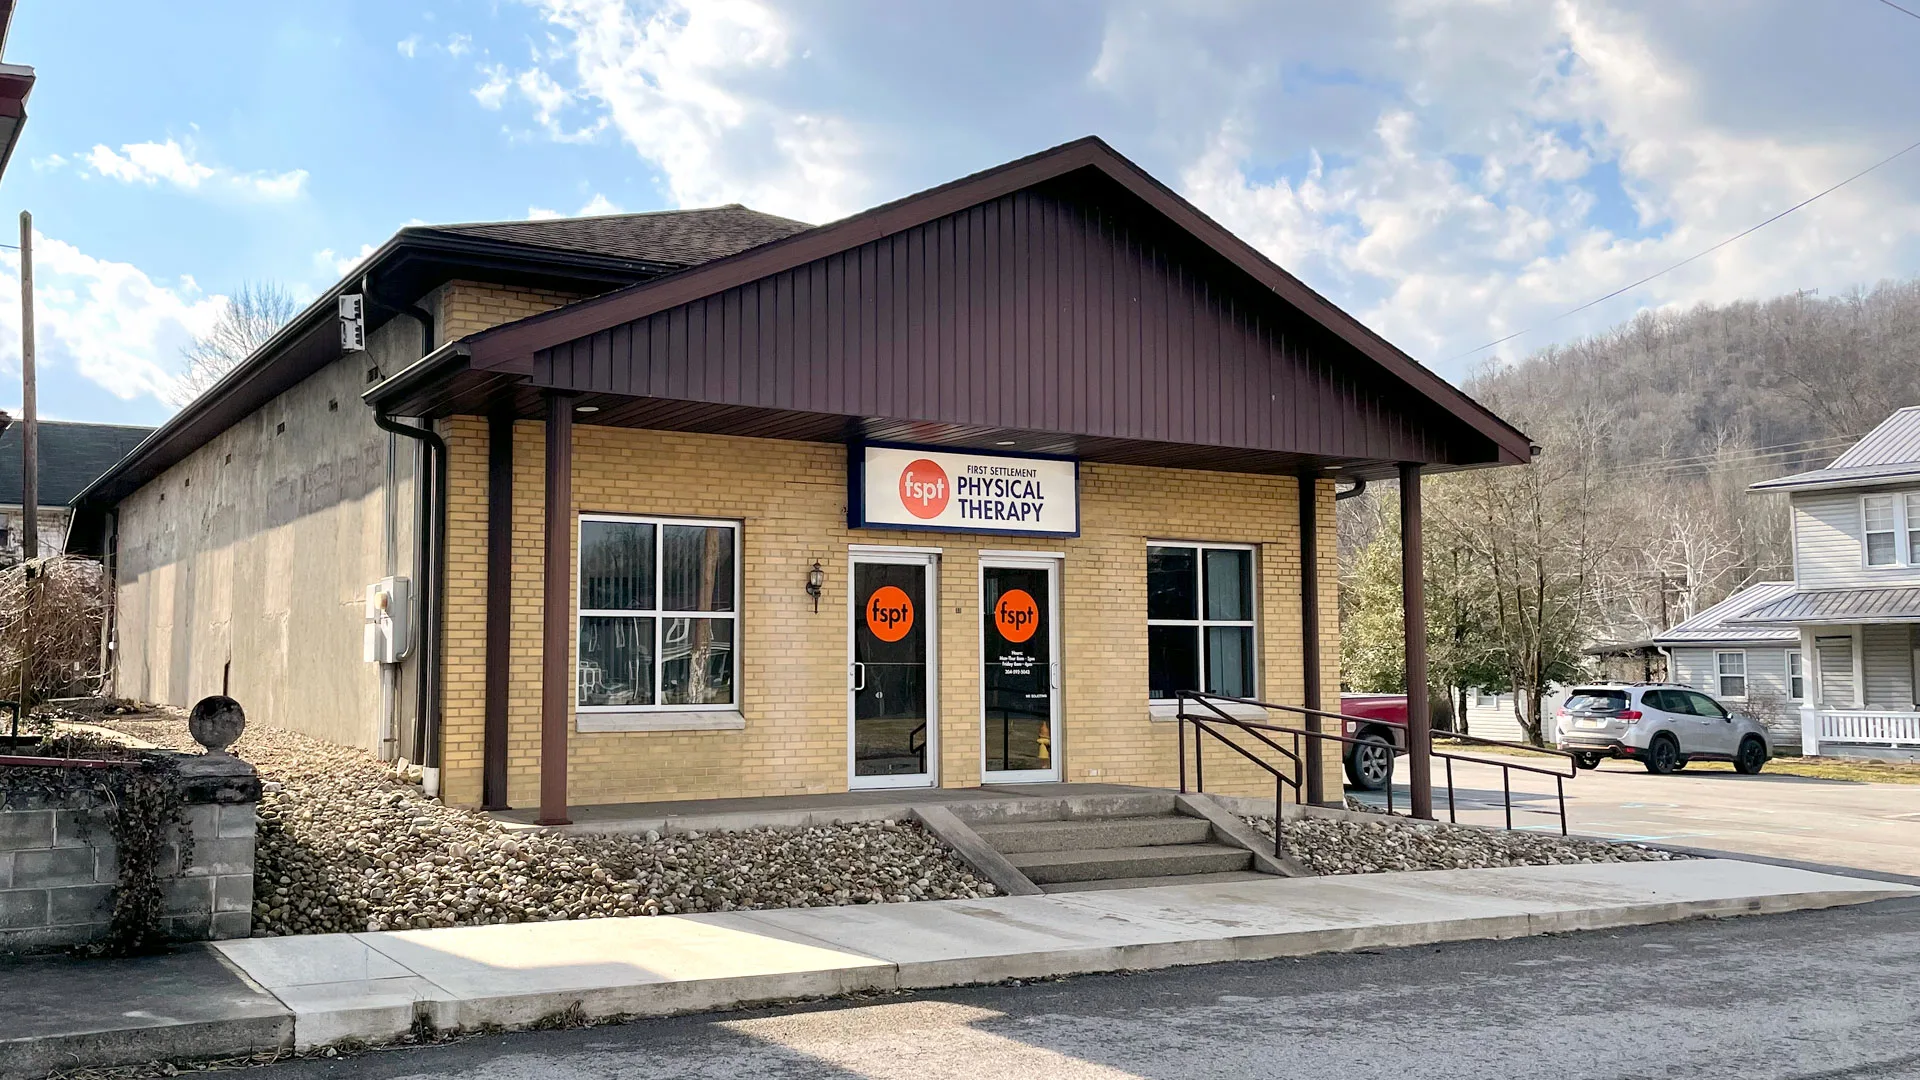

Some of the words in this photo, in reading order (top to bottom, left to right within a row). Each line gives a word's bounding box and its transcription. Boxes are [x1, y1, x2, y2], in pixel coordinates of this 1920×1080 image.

[967, 465, 987, 475] FIRST
[990, 466, 1037, 478] SETTLEMENT
[905, 471, 944, 506] fspt
[957, 476, 1044, 500] PHYSICAL
[958, 498, 1044, 522] THERAPY
[872, 598, 908, 629] fspt
[1000, 601, 1034, 630] fspt
